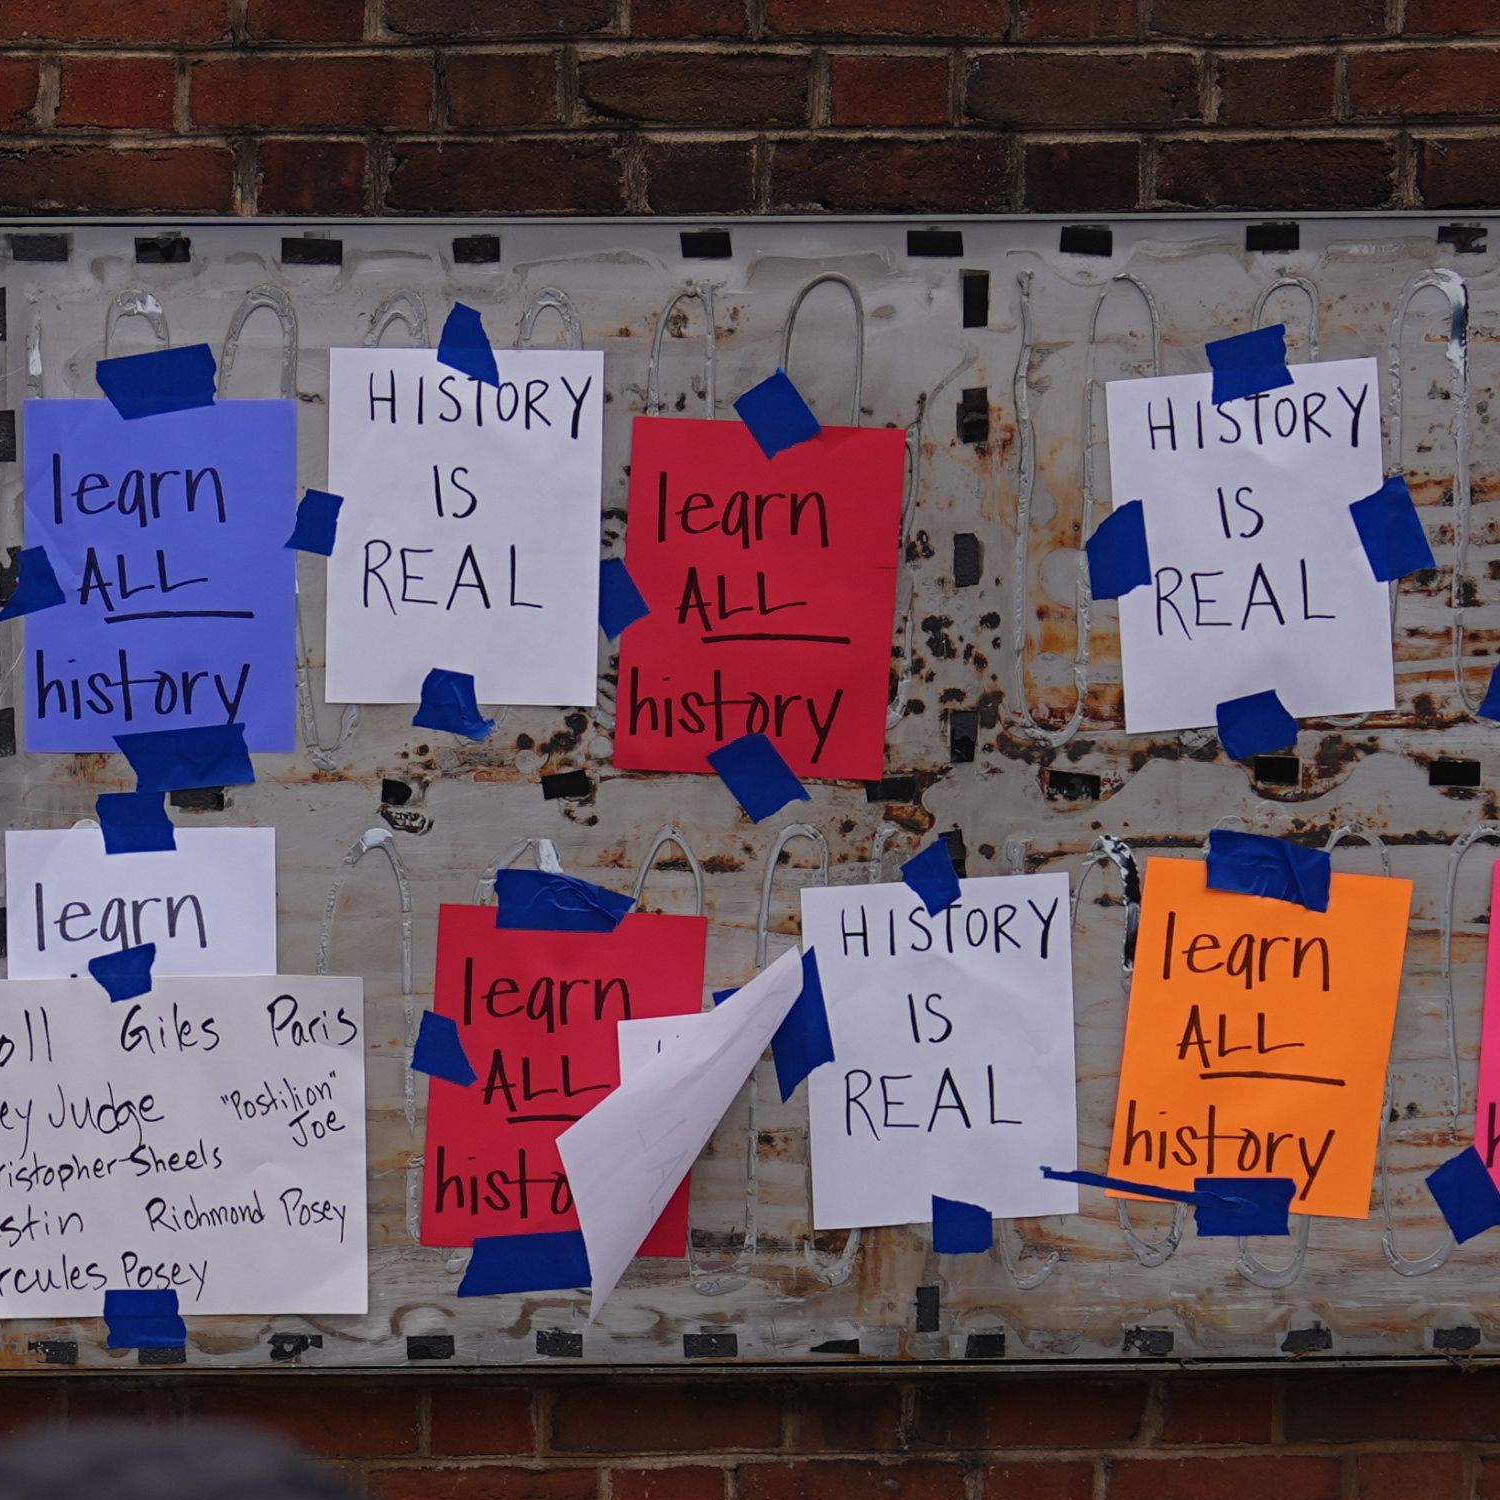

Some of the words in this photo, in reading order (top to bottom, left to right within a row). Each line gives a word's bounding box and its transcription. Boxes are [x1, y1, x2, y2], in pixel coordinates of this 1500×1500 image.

[369, 369, 592, 439] HISTORY
[1147, 384, 1368, 451] HISTORY
[52, 453, 226, 528] learn
[432, 464, 478, 518] IS
[658, 471, 829, 548] learn
[1217, 487, 1263, 539] IS
[77, 546, 208, 611] ALL
[363, 538, 543, 615] REAL
[676, 566, 807, 632] ALL
[1156, 558, 1336, 638] REAL
[36, 649, 250, 724] history
[627, 666, 843, 764] history
[35, 881, 207, 951] learn
[840, 897, 1058, 959] HISTORY
[1162, 911, 1330, 991] learn
[267, 994, 358, 1048] Paris
[463, 957, 632, 1034] learn
[908, 994, 952, 1042] IS
[1178, 1005, 1304, 1067] ALL
[48, 1081, 164, 1146] Judge
[483, 1048, 611, 1113] ALL
[845, 1065, 1022, 1140] REAL
[288, 1108, 346, 1148] Joe
[1123, 1100, 1335, 1200] history
[144, 1189, 265, 1234] Richmond
[279, 1187, 348, 1243] Posey
[435, 1146, 575, 1218] histo
[121, 1250, 209, 1302] Posey
